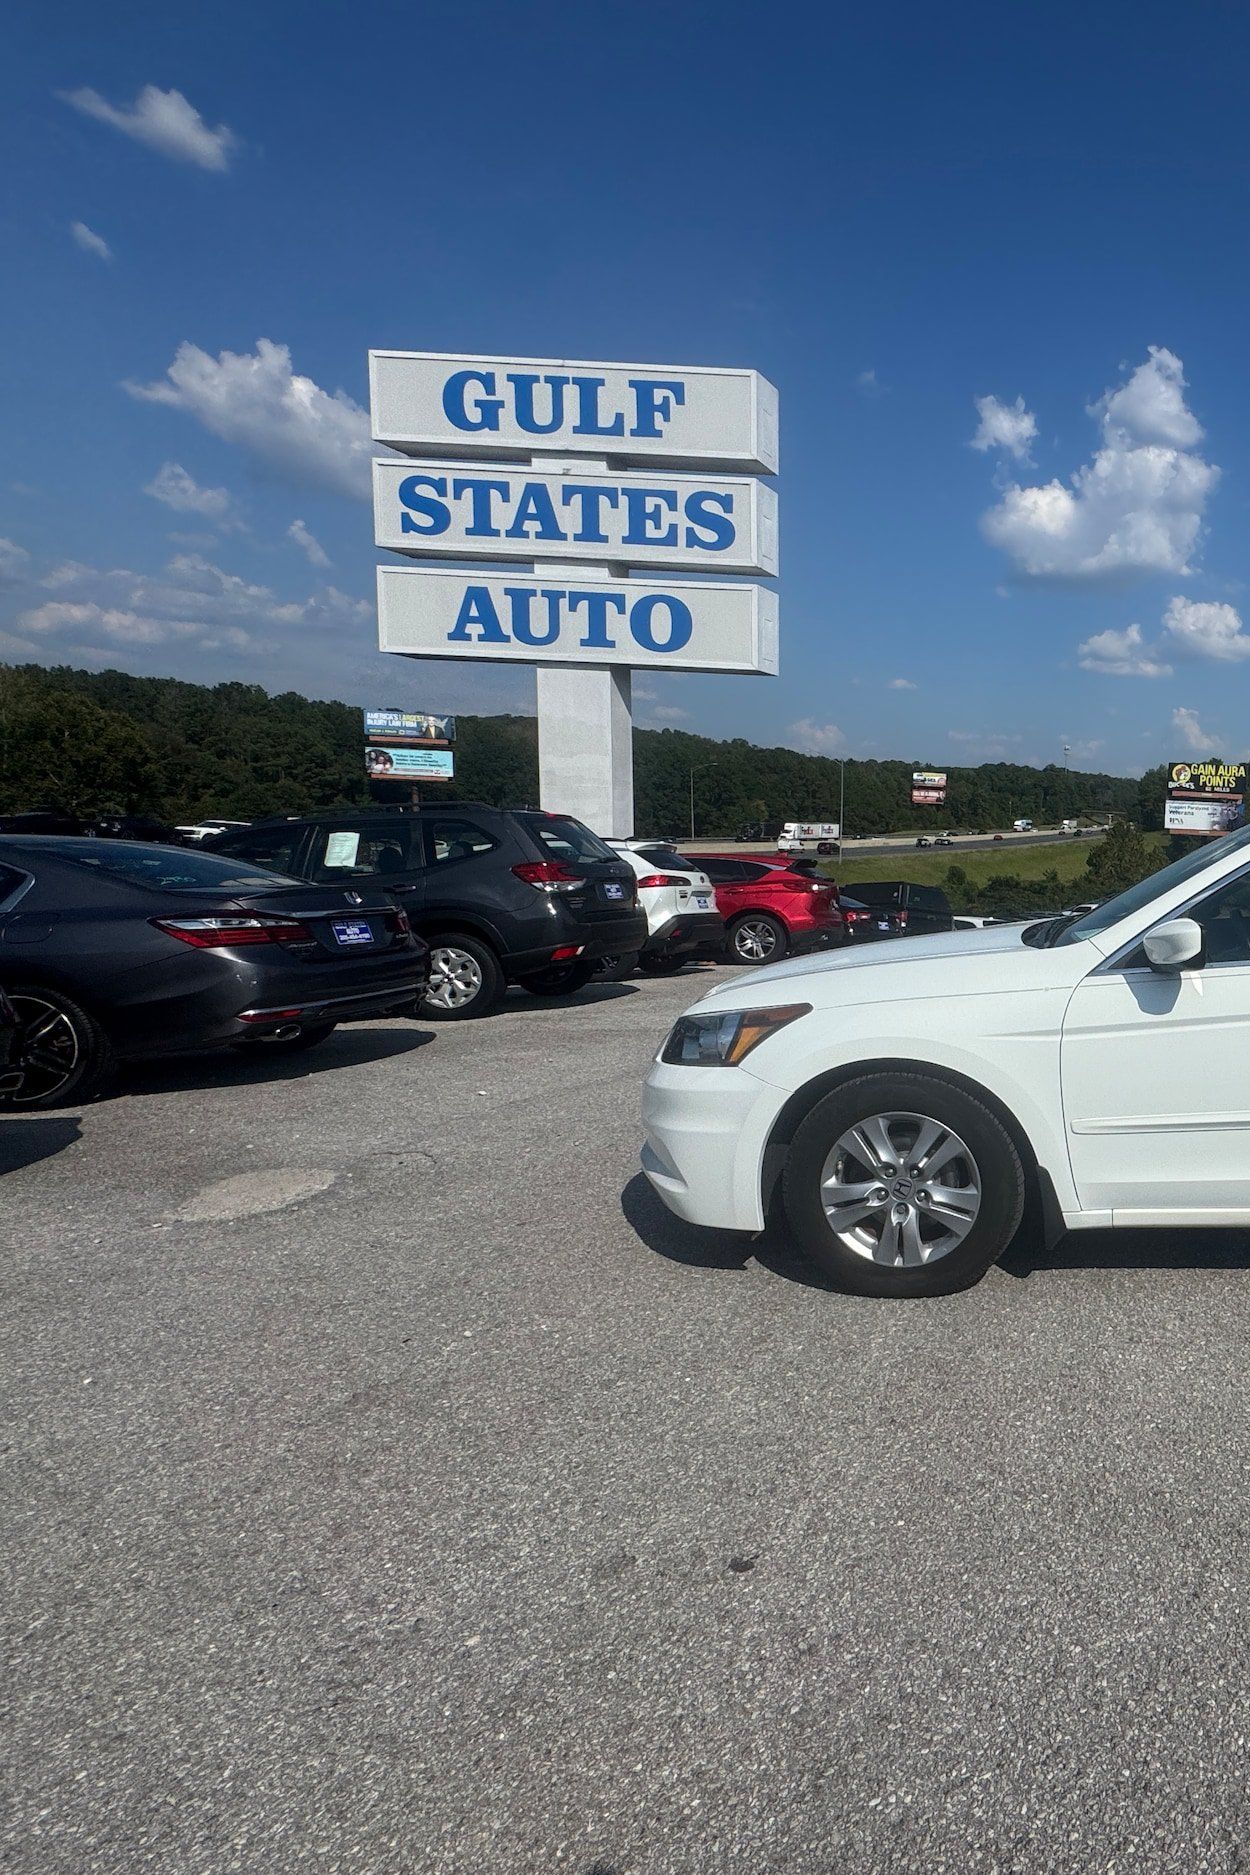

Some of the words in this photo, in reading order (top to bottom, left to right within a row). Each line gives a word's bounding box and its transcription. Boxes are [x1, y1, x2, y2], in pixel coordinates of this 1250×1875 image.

[442, 370, 686, 439] GULF
[398, 475, 737, 552] STATES
[447, 585, 694, 653] AUTO
[1191, 764, 1215, 775] GAIN
[1217, 765, 1246, 777] AURA
[1199, 776, 1236, 788] POINTS
